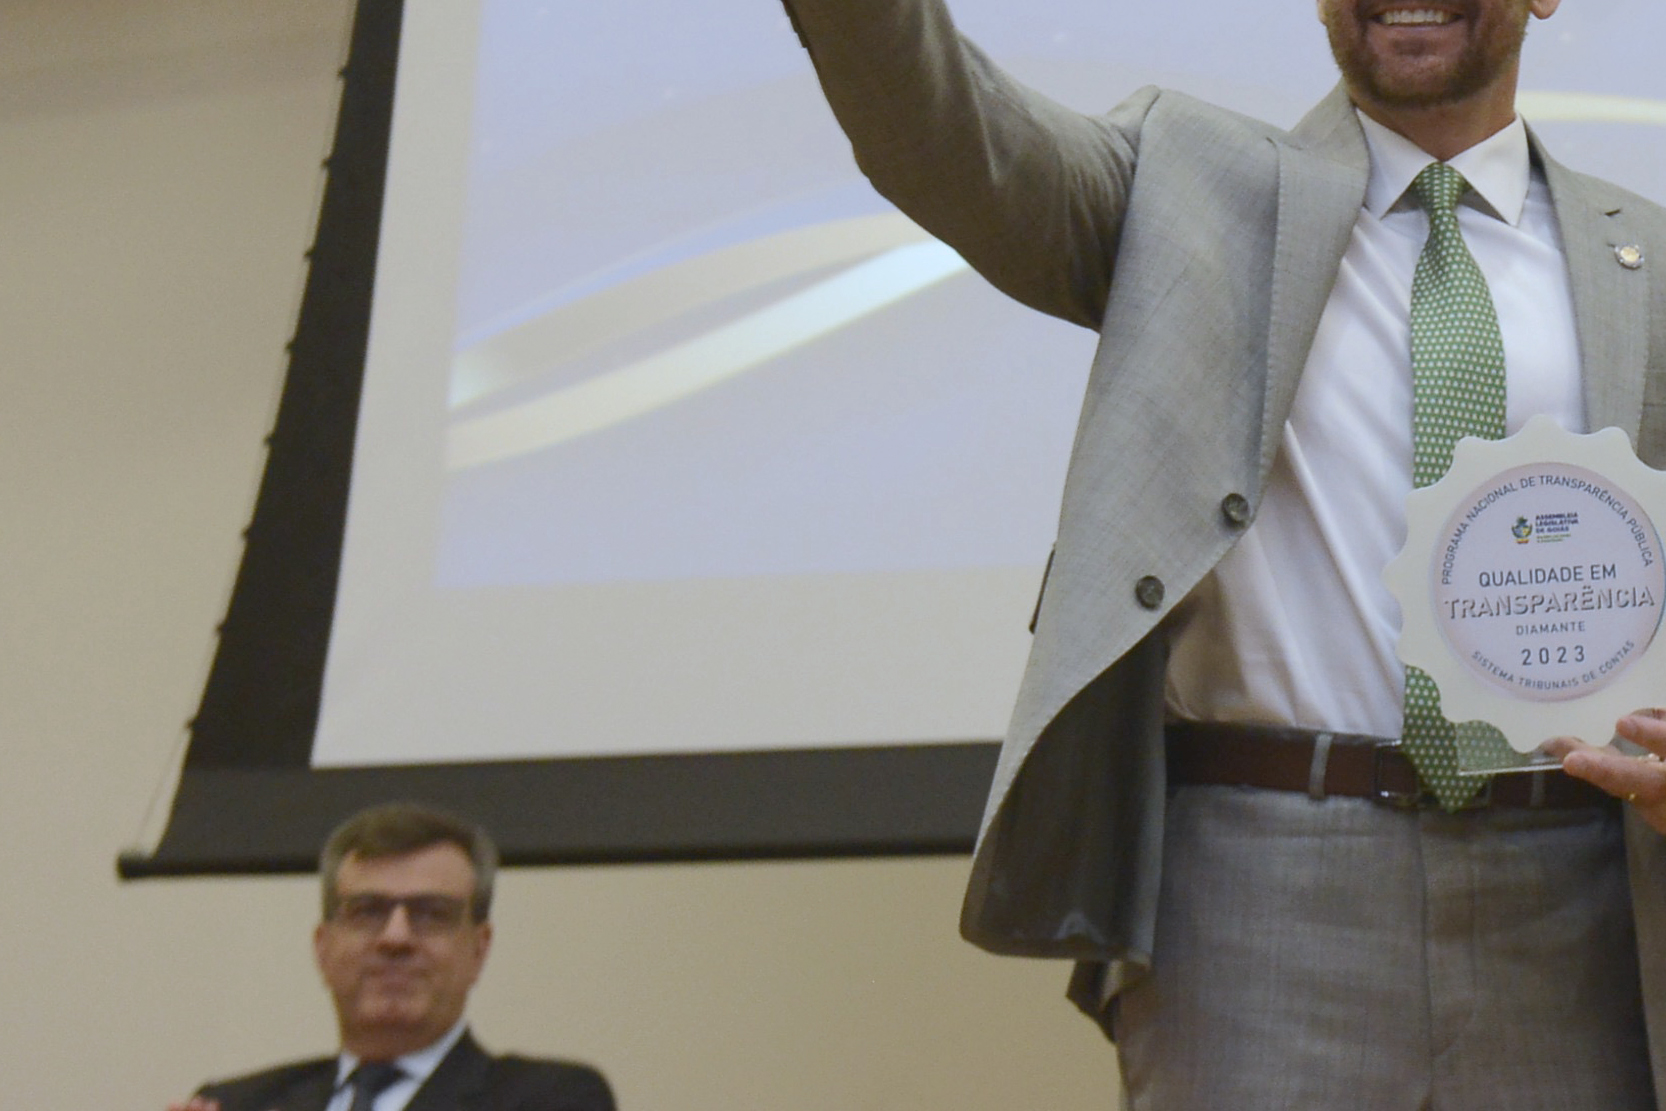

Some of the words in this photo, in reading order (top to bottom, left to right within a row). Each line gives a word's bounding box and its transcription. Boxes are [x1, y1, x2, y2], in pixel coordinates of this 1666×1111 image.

[1441, 522, 1470, 585] PROGRAMA
[1466, 482, 1518, 522] NACIONAL
[1520, 476, 1536, 489] DE
[1539, 474, 1628, 520] TRANSPARÊNCIA
[1625, 517, 1653, 567] PÚBLICA
[1478, 565, 1584, 588] QUALIDADE
[1590, 563, 1616, 581] EM
[1516, 621, 1586, 636] DIAMANTE
[1471, 650, 1514, 683] SISTEMA
[1519, 677, 1579, 689] TRIBUNAIS
[1582, 670, 1596, 684] DE
[1599, 639, 1635, 675] CONTAS
